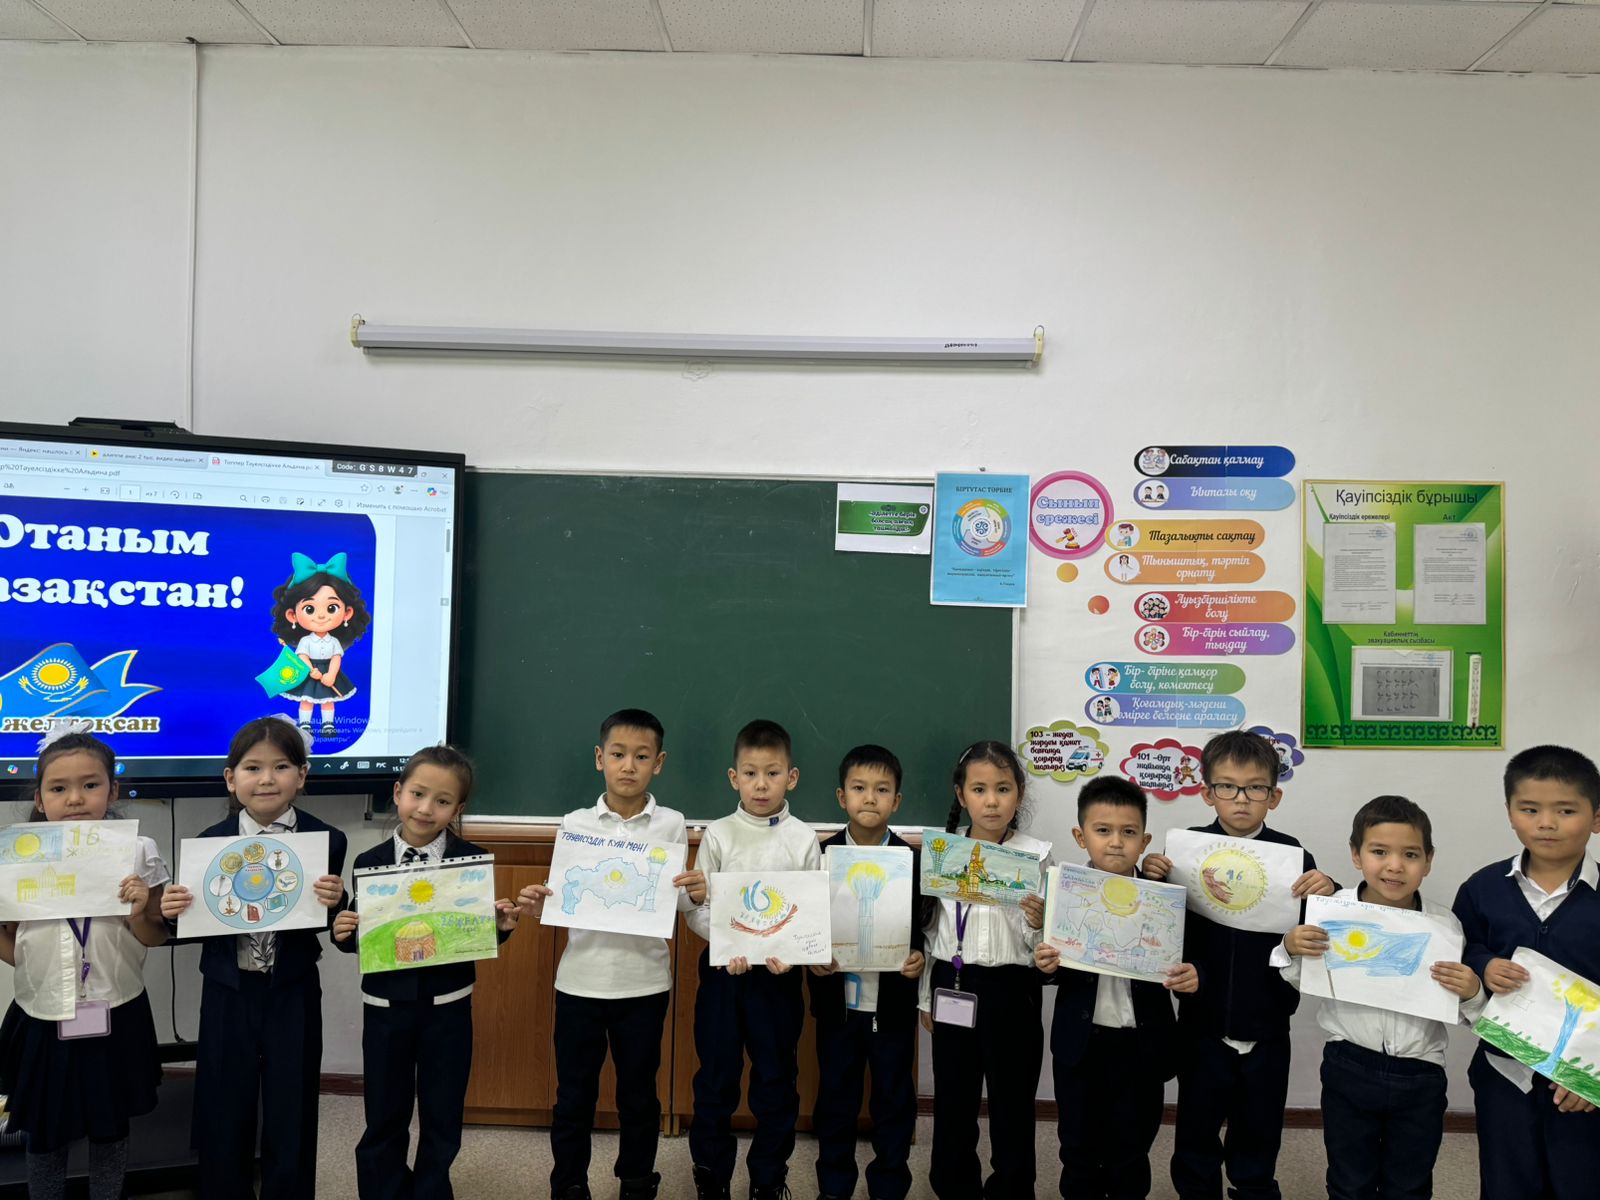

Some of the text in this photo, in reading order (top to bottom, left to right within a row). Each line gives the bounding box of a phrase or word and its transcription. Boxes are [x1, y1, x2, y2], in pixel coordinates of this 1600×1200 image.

[336, 462, 357, 471] Code:
[1169, 453, 1264, 469] Сабақтан қалмау
[1190, 485, 1258, 500] Ынталы оқу
[1335, 488, 1479, 507] Қауіпсіздік бұрышы
[1036, 496, 1100, 509] Сынып
[1036, 513, 1099, 526] ережесі
[1328, 513, 1360, 521] Қауіпсіздік
[1442, 513, 1457, 521] Акт
[0, 513, 211, 556] Отаным
[1149, 529, 1256, 545] Тазалықты сақтау
[1141, 554, 1250, 569] Тыныштық, тәртіп
[1176, 568, 1216, 582] орнату
[0, 575, 244, 609] зақстан!
[1174, 593, 1258, 609] Ауызбіршілікте
[1205, 608, 1229, 623] болу
[1182, 626, 1270, 642] Бір-бірін сыйлау,
[1178, 666, 1218, 681] қамқор
[1130, 678, 1215, 694] болу, көмектесу
[1132, 697, 1228, 710] Қоғамдық-мәдени
[1152, 709, 1193, 722] белсене
[1194, 711, 1238, 726] араласу
[1030, 730, 1044, 738] 103
[1137, 752, 1150, 760] 101
[69, 824, 100, 847] 16
[1226, 869, 1244, 881] 16
[740, 879, 771, 912] 16
